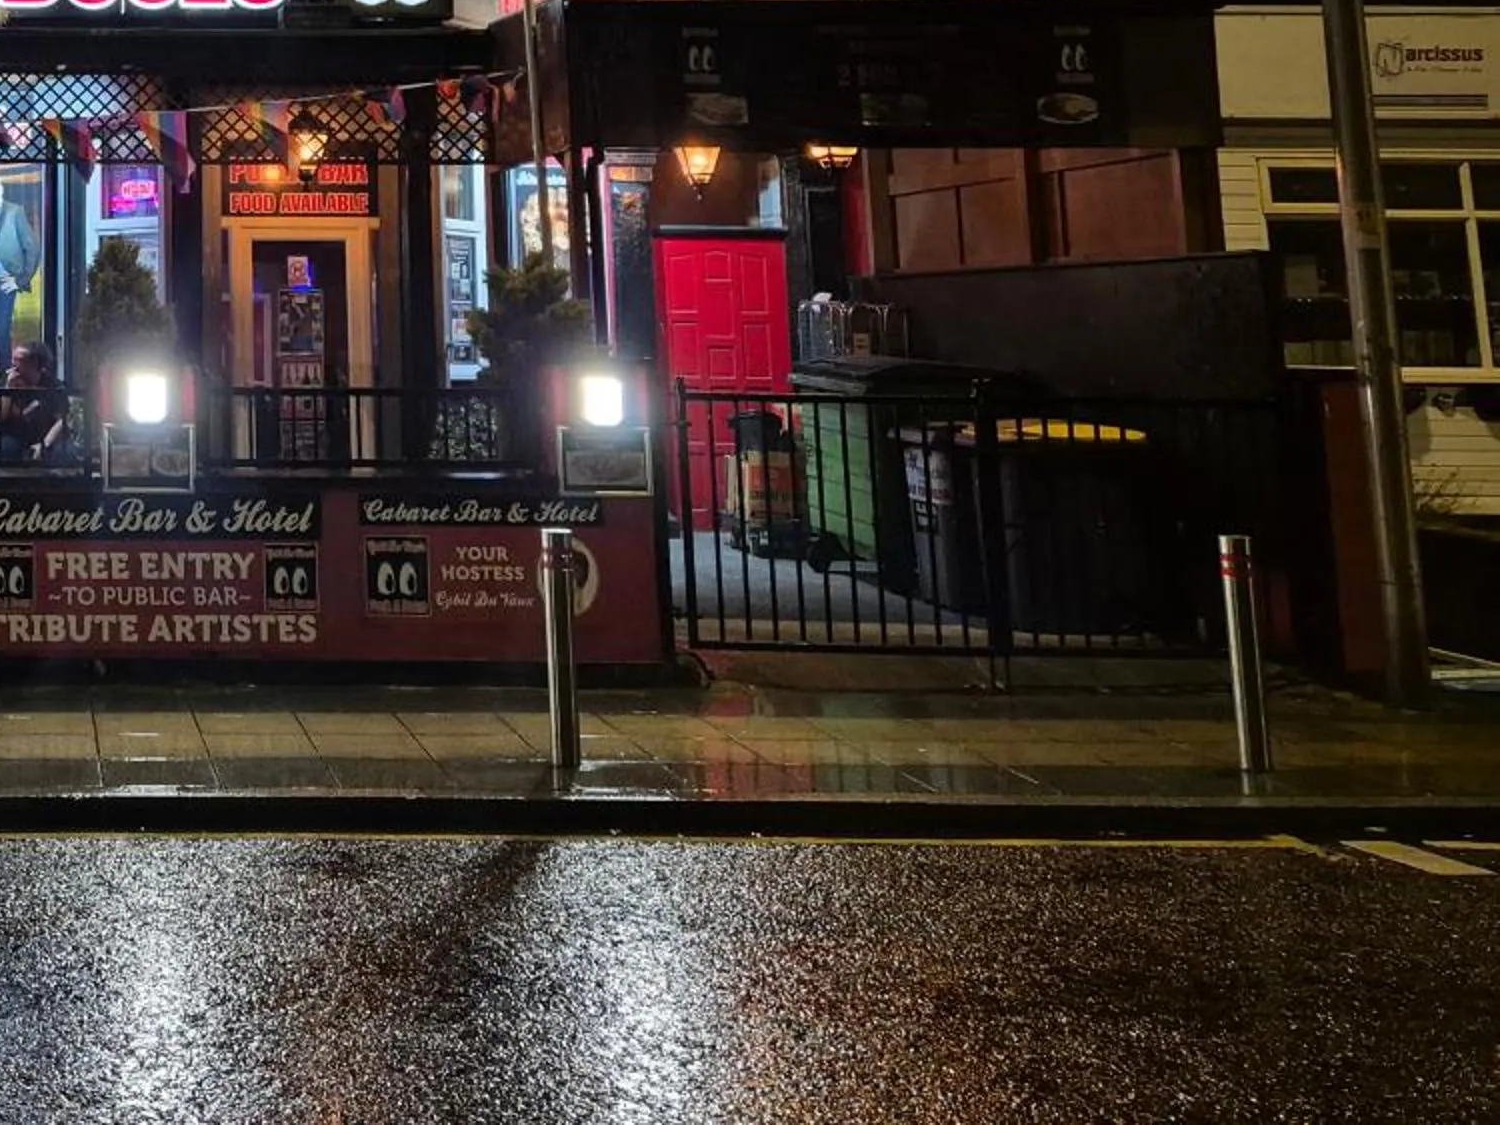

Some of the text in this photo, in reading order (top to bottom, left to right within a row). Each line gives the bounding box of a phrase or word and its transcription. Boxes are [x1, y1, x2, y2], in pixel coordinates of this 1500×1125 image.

[229, 192, 369, 214] FOOD AVAILABLE
[110, 499, 177, 533] Bar
[185, 500, 216, 532] &
[223, 499, 314, 533] Hotel
[363, 499, 597, 522] Cabaret Bar & Hotel
[455, 546, 509, 561] YOUR
[46, 552, 134, 580] FREE
[140, 552, 255, 580] ENTRY
[440, 566, 525, 581] HOSTESS
[102, 587, 186, 606] PUBLIC
[148, 614, 317, 642] ARTISTES
